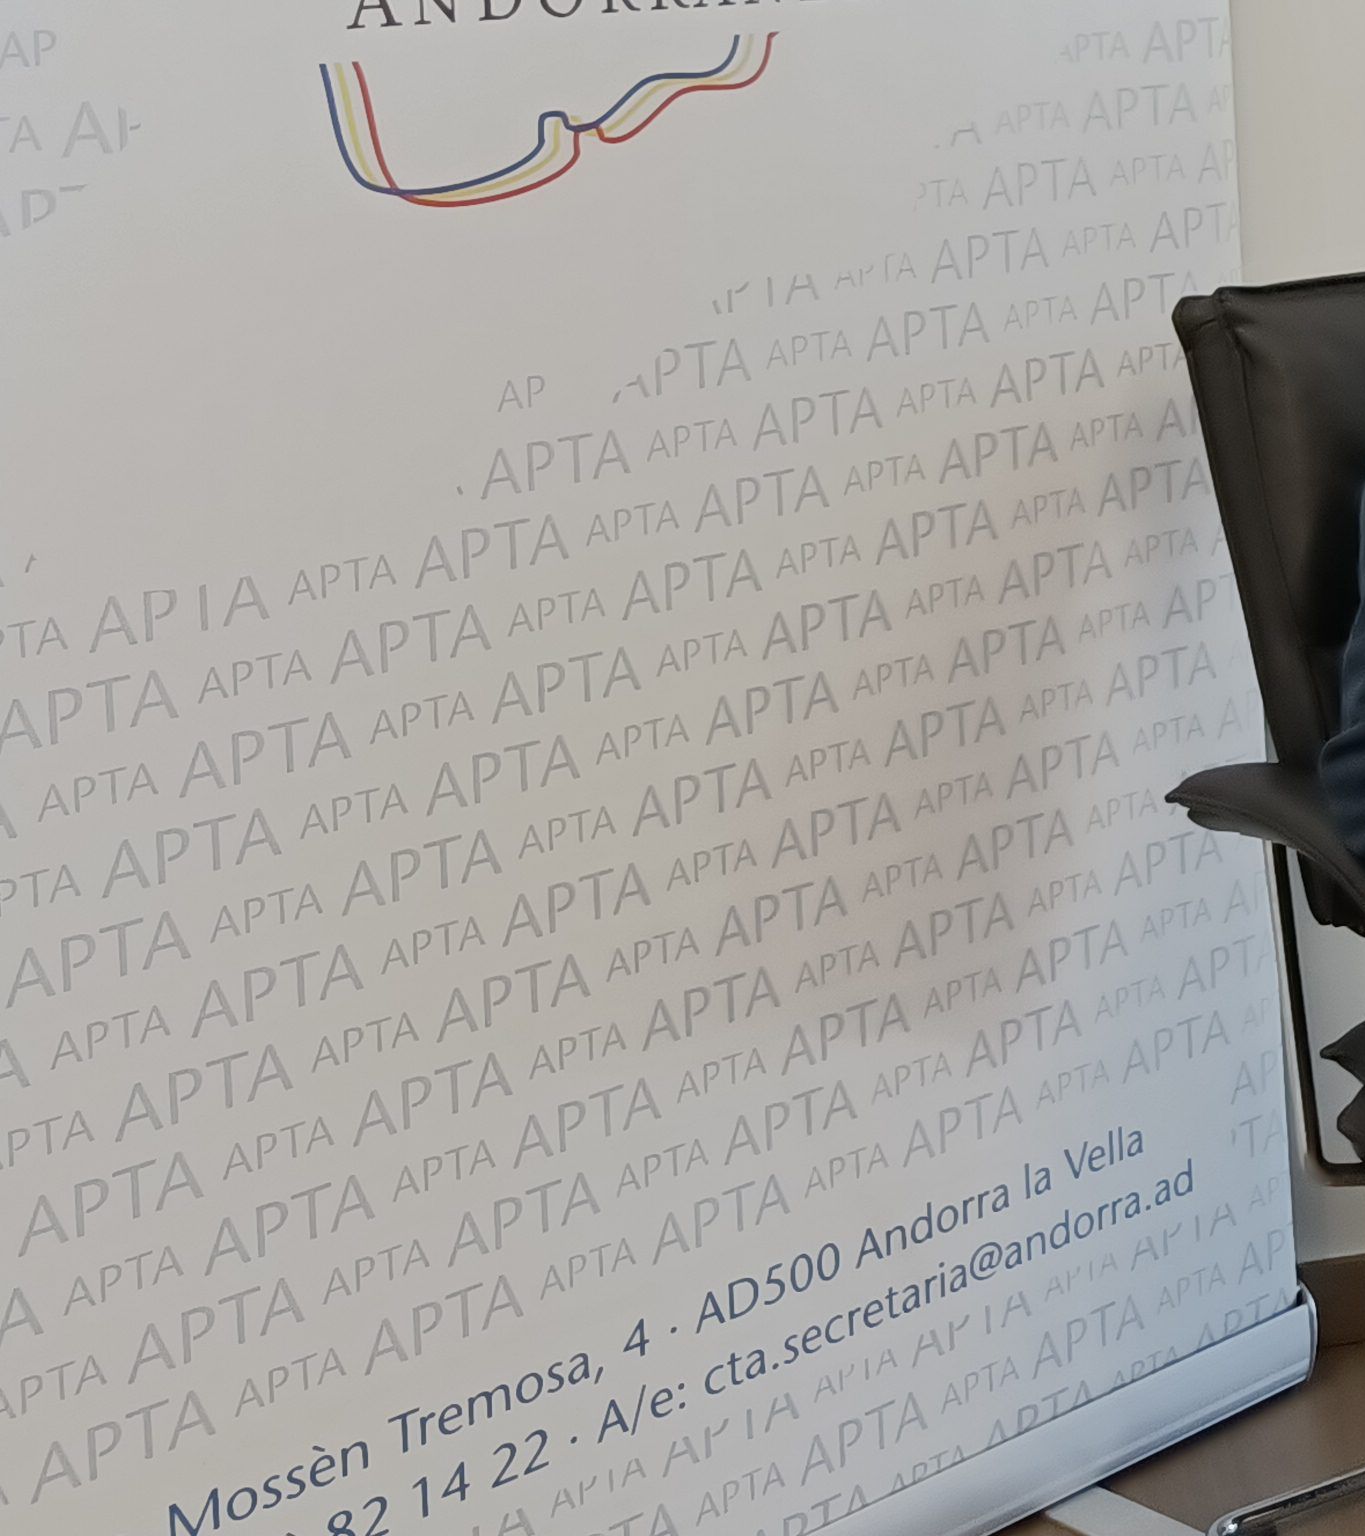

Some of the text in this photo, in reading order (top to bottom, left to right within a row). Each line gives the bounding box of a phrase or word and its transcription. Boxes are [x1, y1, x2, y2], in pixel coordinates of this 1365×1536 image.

[931, 227, 1049, 284] APTA
[288, 412, 1144, 605] APTA APTA APTA APTA APTA
[480, 348, 1104, 500] APTA APTA APTA
[0, 500, 999, 752] APTA APTA APTA APTA APTA APTA
[37, 543, 1112, 822] APTA APTA APTA APTA APTA APTA
[101, 615, 1066, 899] APTA APTA APTA APTA APTA APTA
[5, 645, 1216, 1009] APTA APTA APTA APTA APTA APTA APTA
[50, 792, 902, 1070] APTA APTA APTA APTA APTA APTA
[115, 809, 1074, 1143] APTA APTA APTA APTA APTA APTA
[0, 1000, 1082, 1419] APTA APTA APTA APTA APTA
[18, 891, 1015, 1258] APTA APTA APTA APTA APTA APTA
[63, 993, 910, 1316] APTA APTA APTA APTA APTA
[30, 1174, 791, 1505] APTA APTA APTA APTA
[168, 1127, 1143, 1536] Mossèn Tremosa, 4 AD500 Andorra la Vella
[413, 1462, 470, 1518] 14
[492, 1429, 549, 1488] 22
[705, 1158, 1193, 1394] cta.secretaria@andorra.ad
[695, 1295, 1145, 1527] APTA APTA APTA
